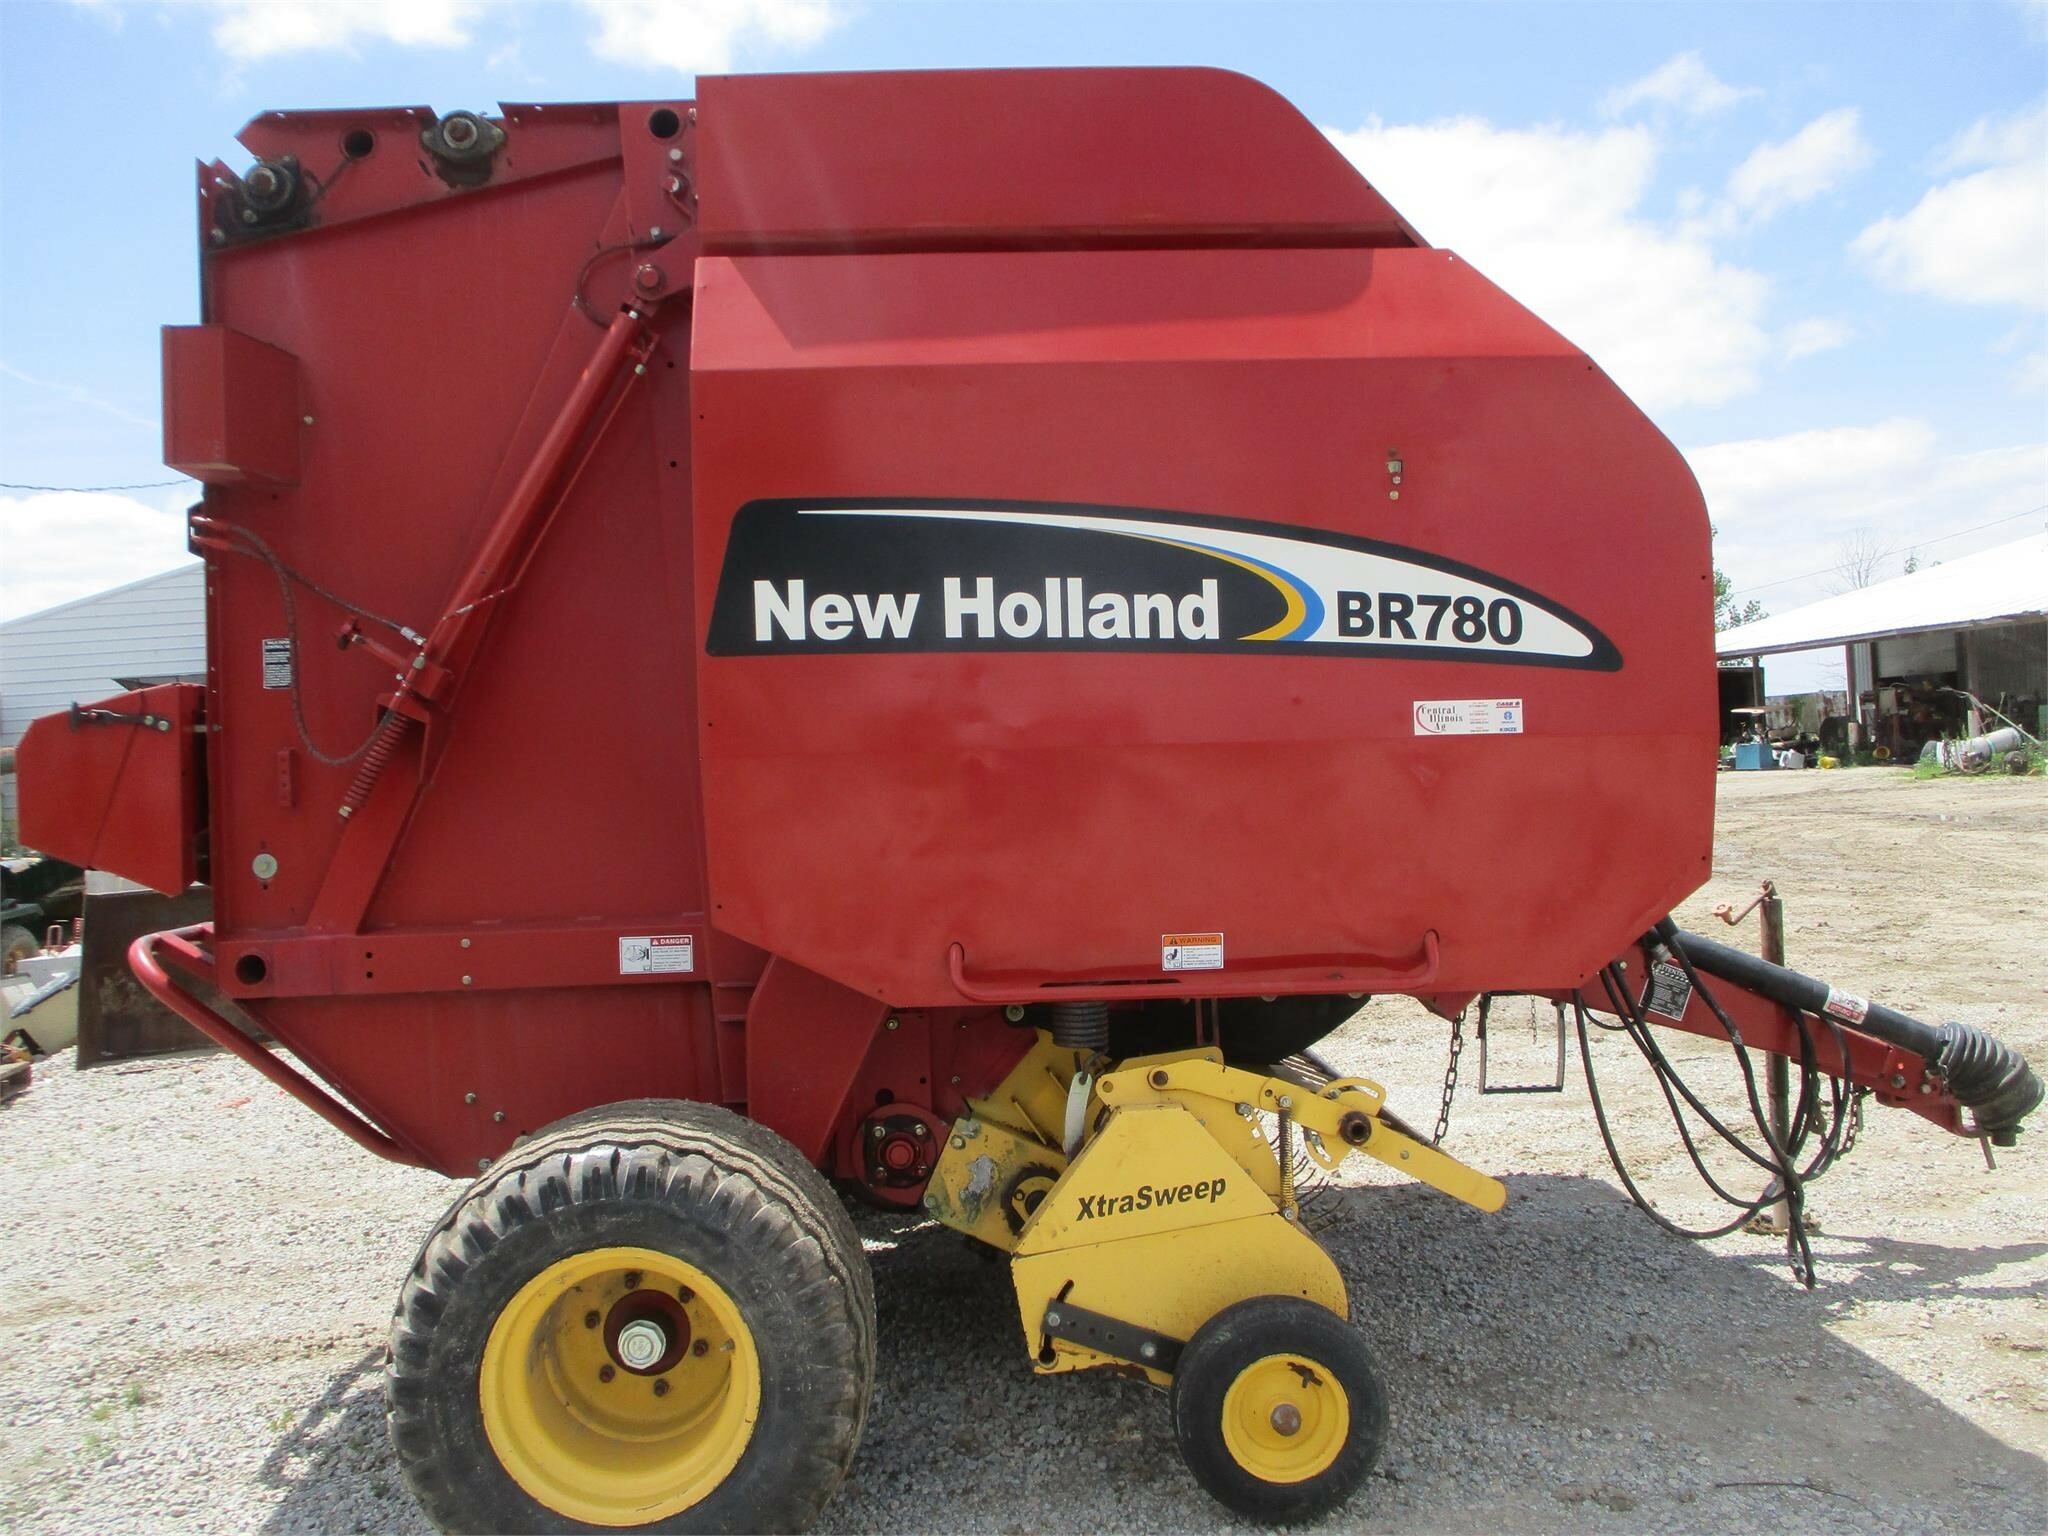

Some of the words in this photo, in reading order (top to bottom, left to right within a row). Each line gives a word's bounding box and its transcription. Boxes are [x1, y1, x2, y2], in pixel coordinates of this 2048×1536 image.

[754, 579, 920, 641] New
[944, 577, 1219, 640] Holland
[1337, 591, 1523, 645] BR780
[1421, 705, 1455, 714] Central
[1430, 714, 1463, 722] Illinois
[660, 937, 690, 945] DANGER
[1076, 1177, 1227, 1221] XtraSweep
